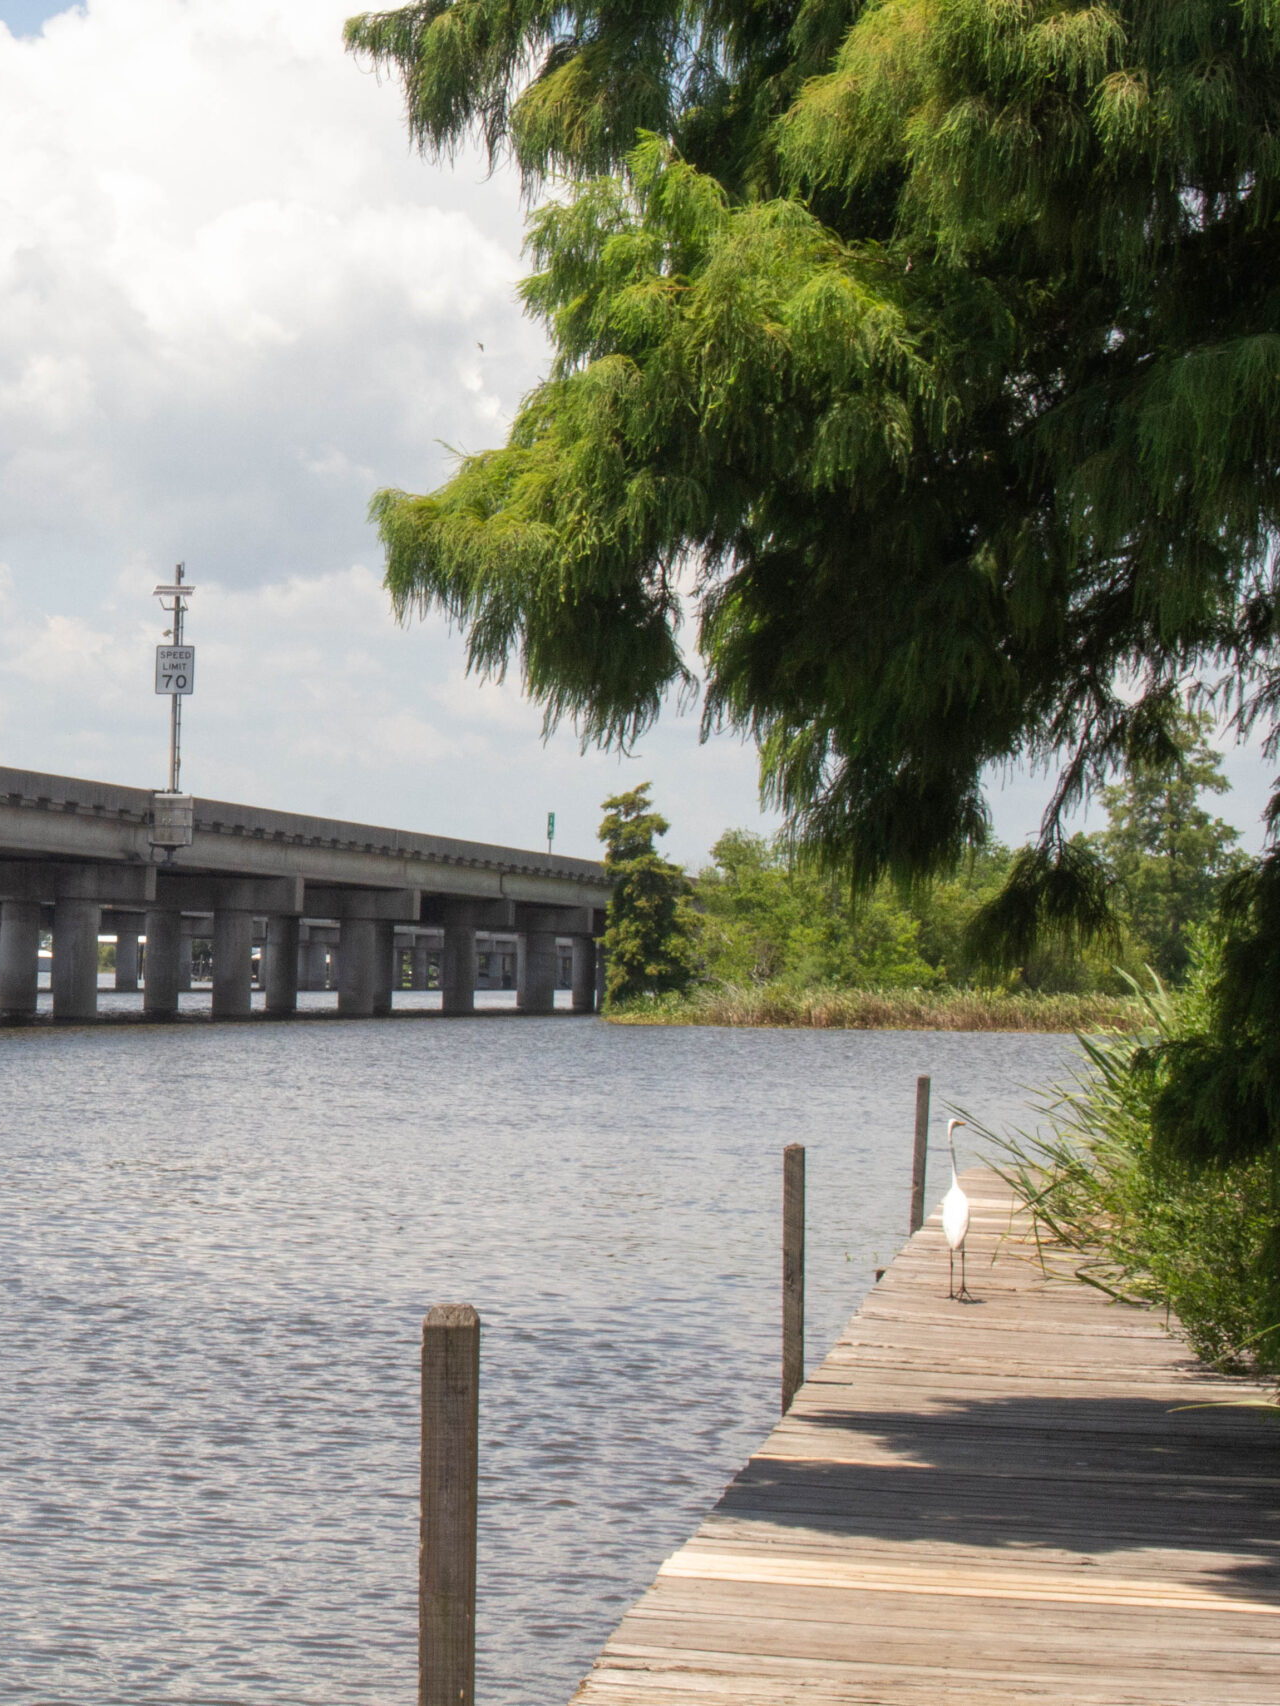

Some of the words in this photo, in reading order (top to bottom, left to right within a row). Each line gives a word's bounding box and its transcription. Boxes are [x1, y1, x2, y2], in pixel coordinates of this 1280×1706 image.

[160, 651, 191, 659] SPEED
[162, 663, 186, 671] LIMIT
[162, 674, 187, 688] 70
